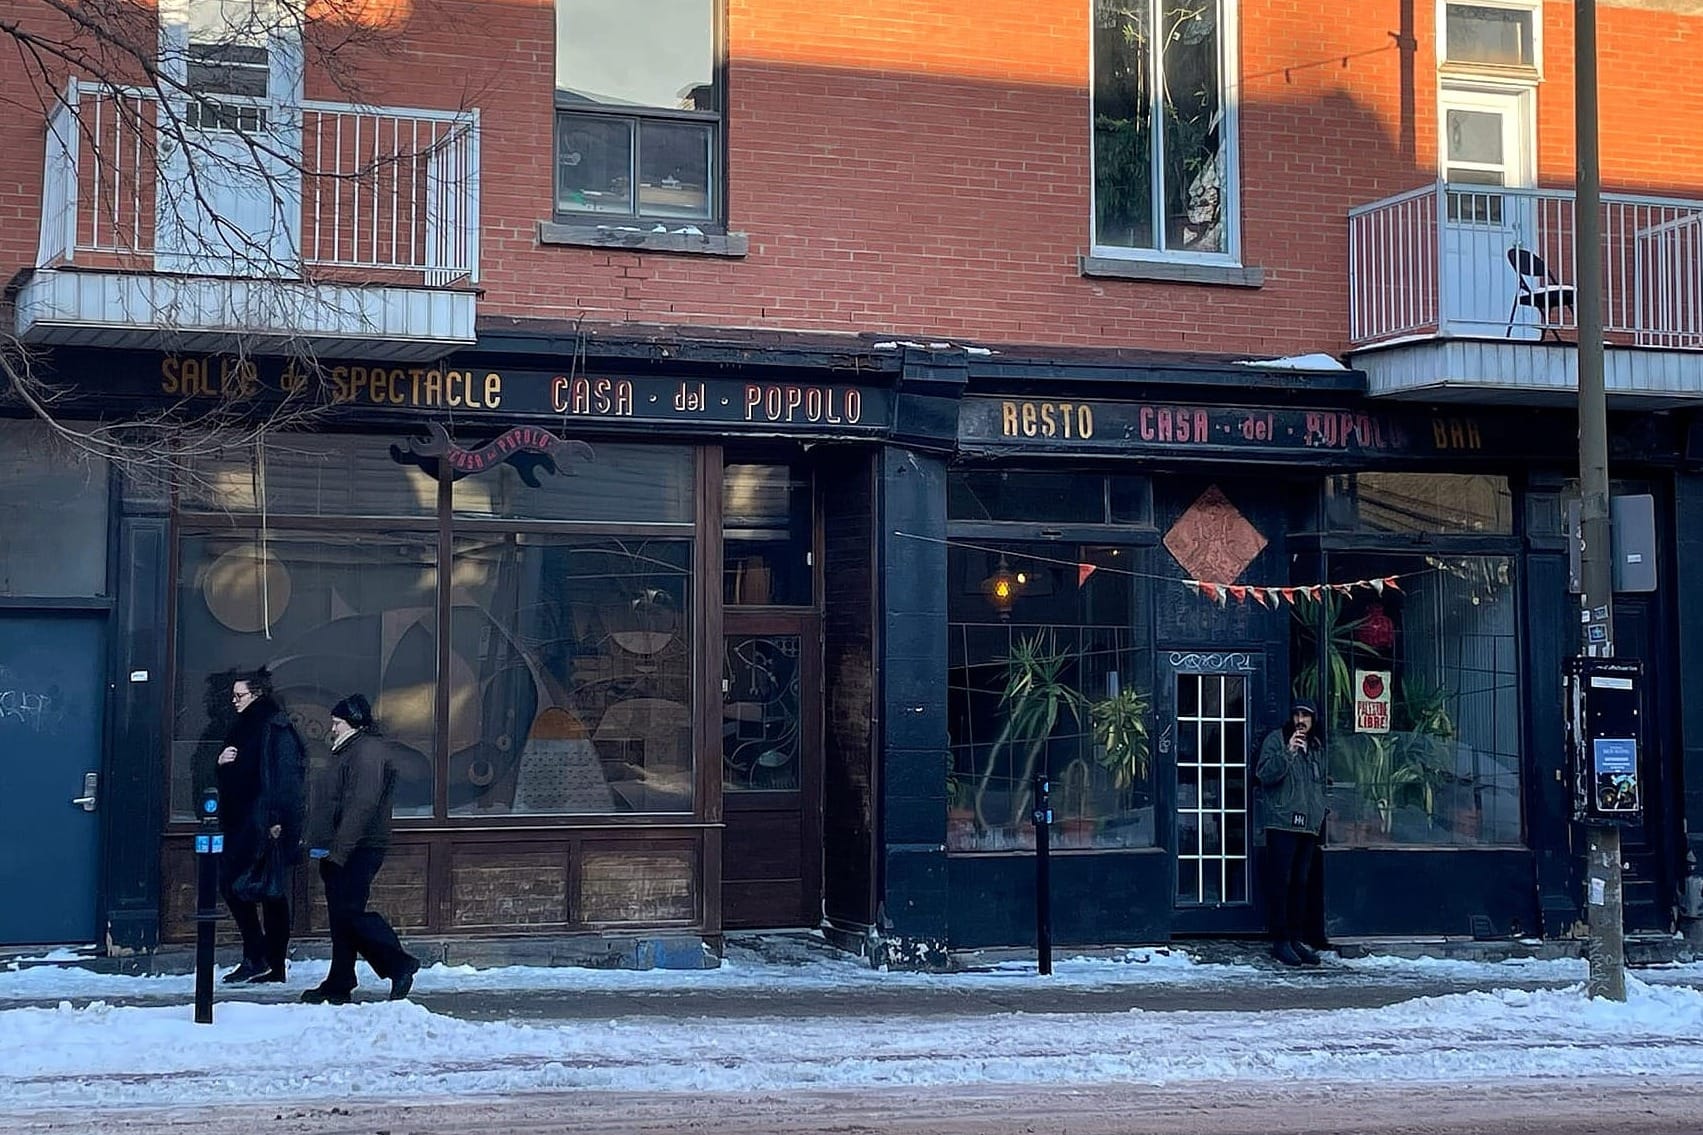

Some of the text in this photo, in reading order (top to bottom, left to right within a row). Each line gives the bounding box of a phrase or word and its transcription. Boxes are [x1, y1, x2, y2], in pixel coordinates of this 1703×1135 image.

[551, 376, 862, 424] CASA del POPOLO
[497, 429, 548, 453] POPOLO
[1139, 406, 1208, 442] CASA
[1243, 413, 1273, 441] del
